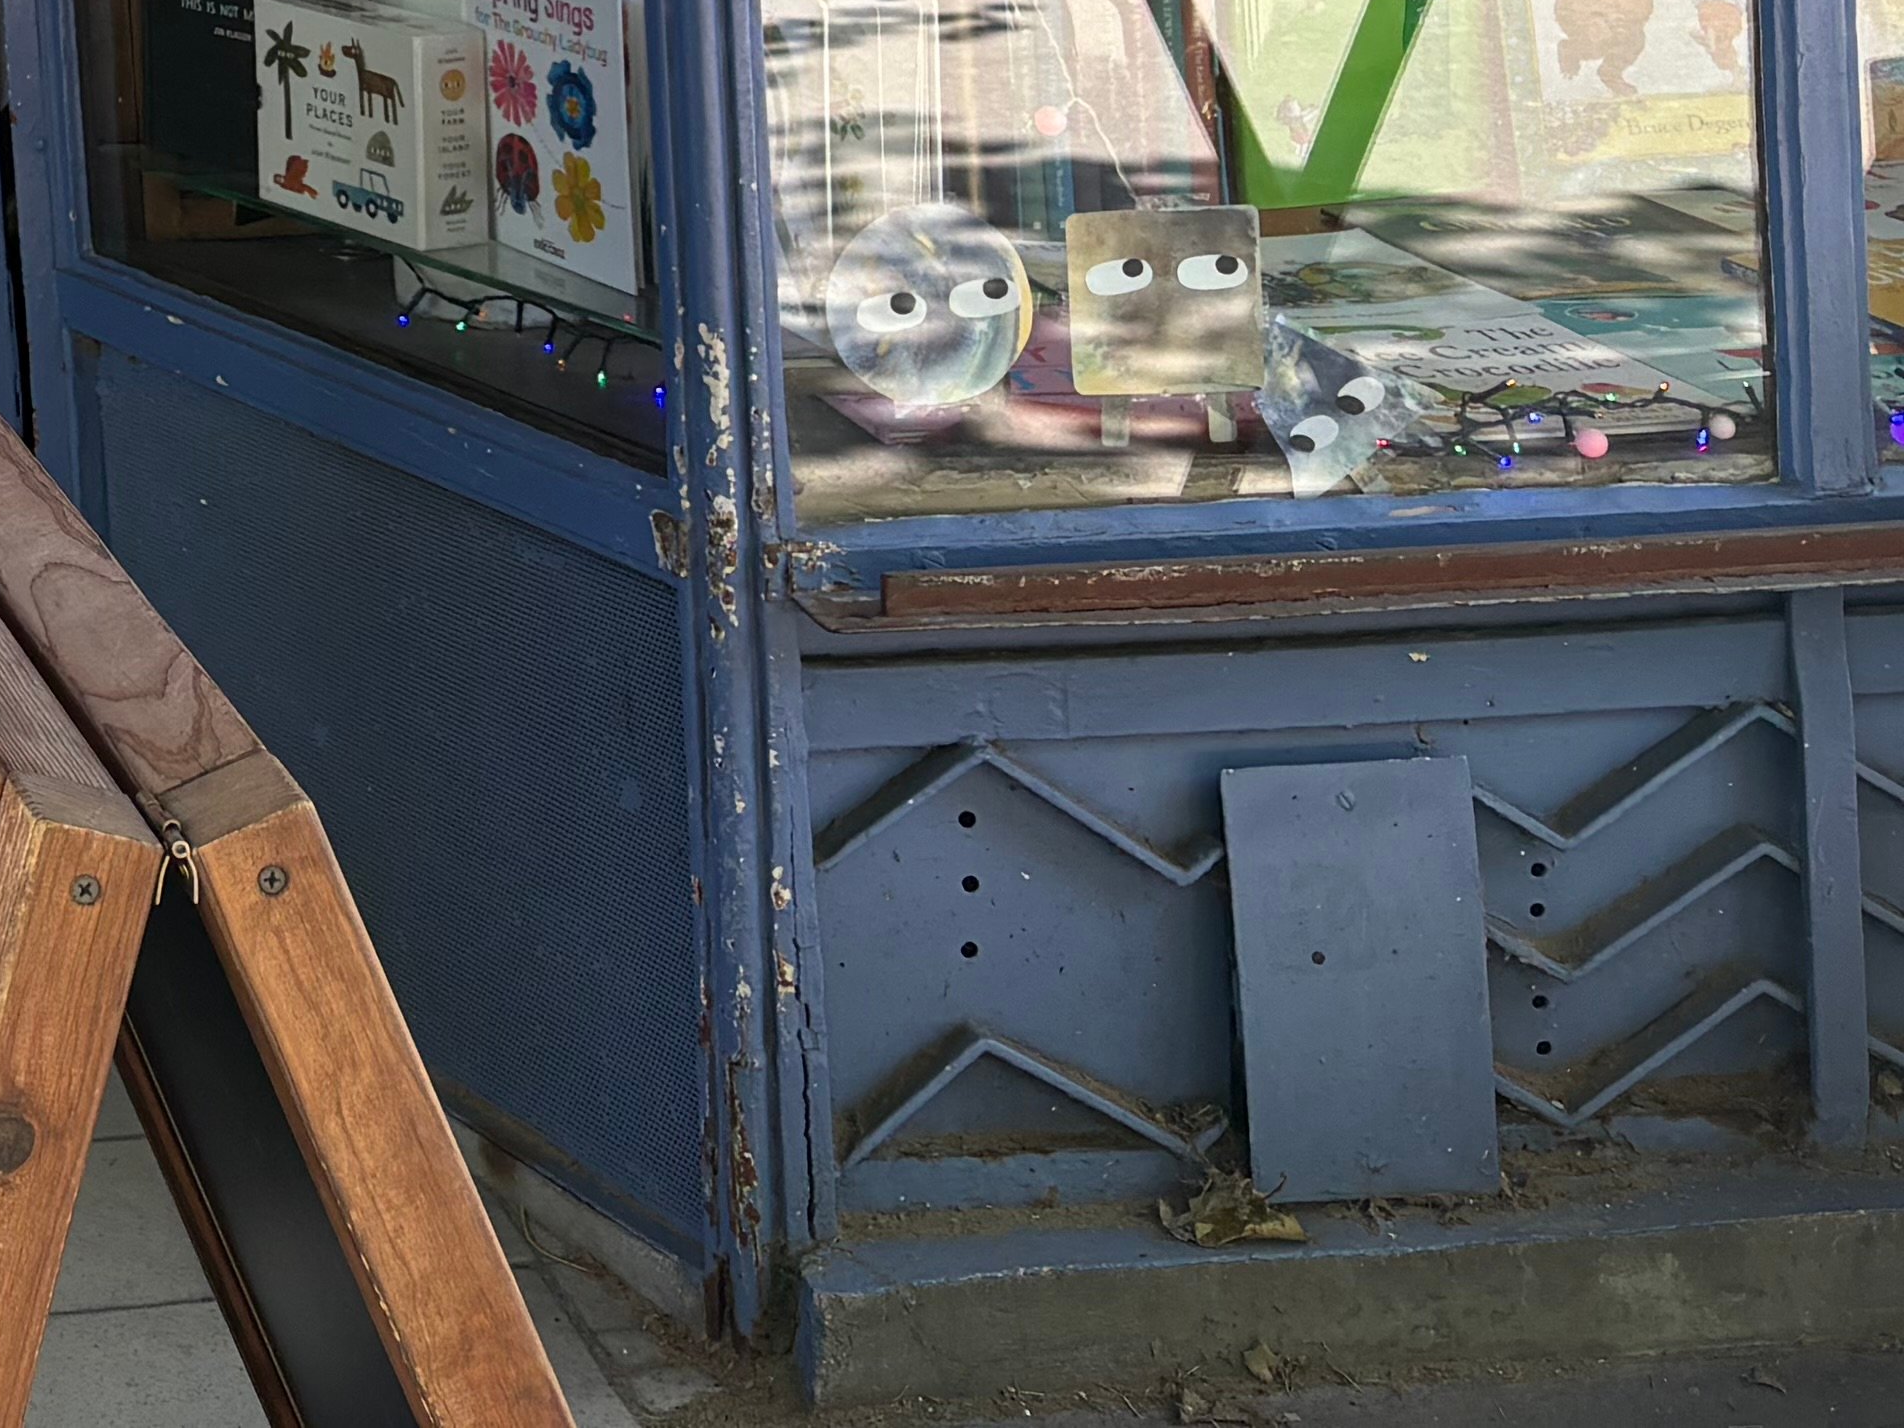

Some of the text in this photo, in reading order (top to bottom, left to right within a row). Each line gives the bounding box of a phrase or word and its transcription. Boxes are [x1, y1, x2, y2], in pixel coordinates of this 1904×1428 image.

[206, 0, 217, 14] IS
[219, 4, 240, 19] NOT
[492, 11, 512, 34] The
[312, 86, 347, 108] YOUR
[306, 103, 354, 129] PLACES
[1463, 324, 1555, 342] The
[1392, 356, 1623, 382] Crocodile
